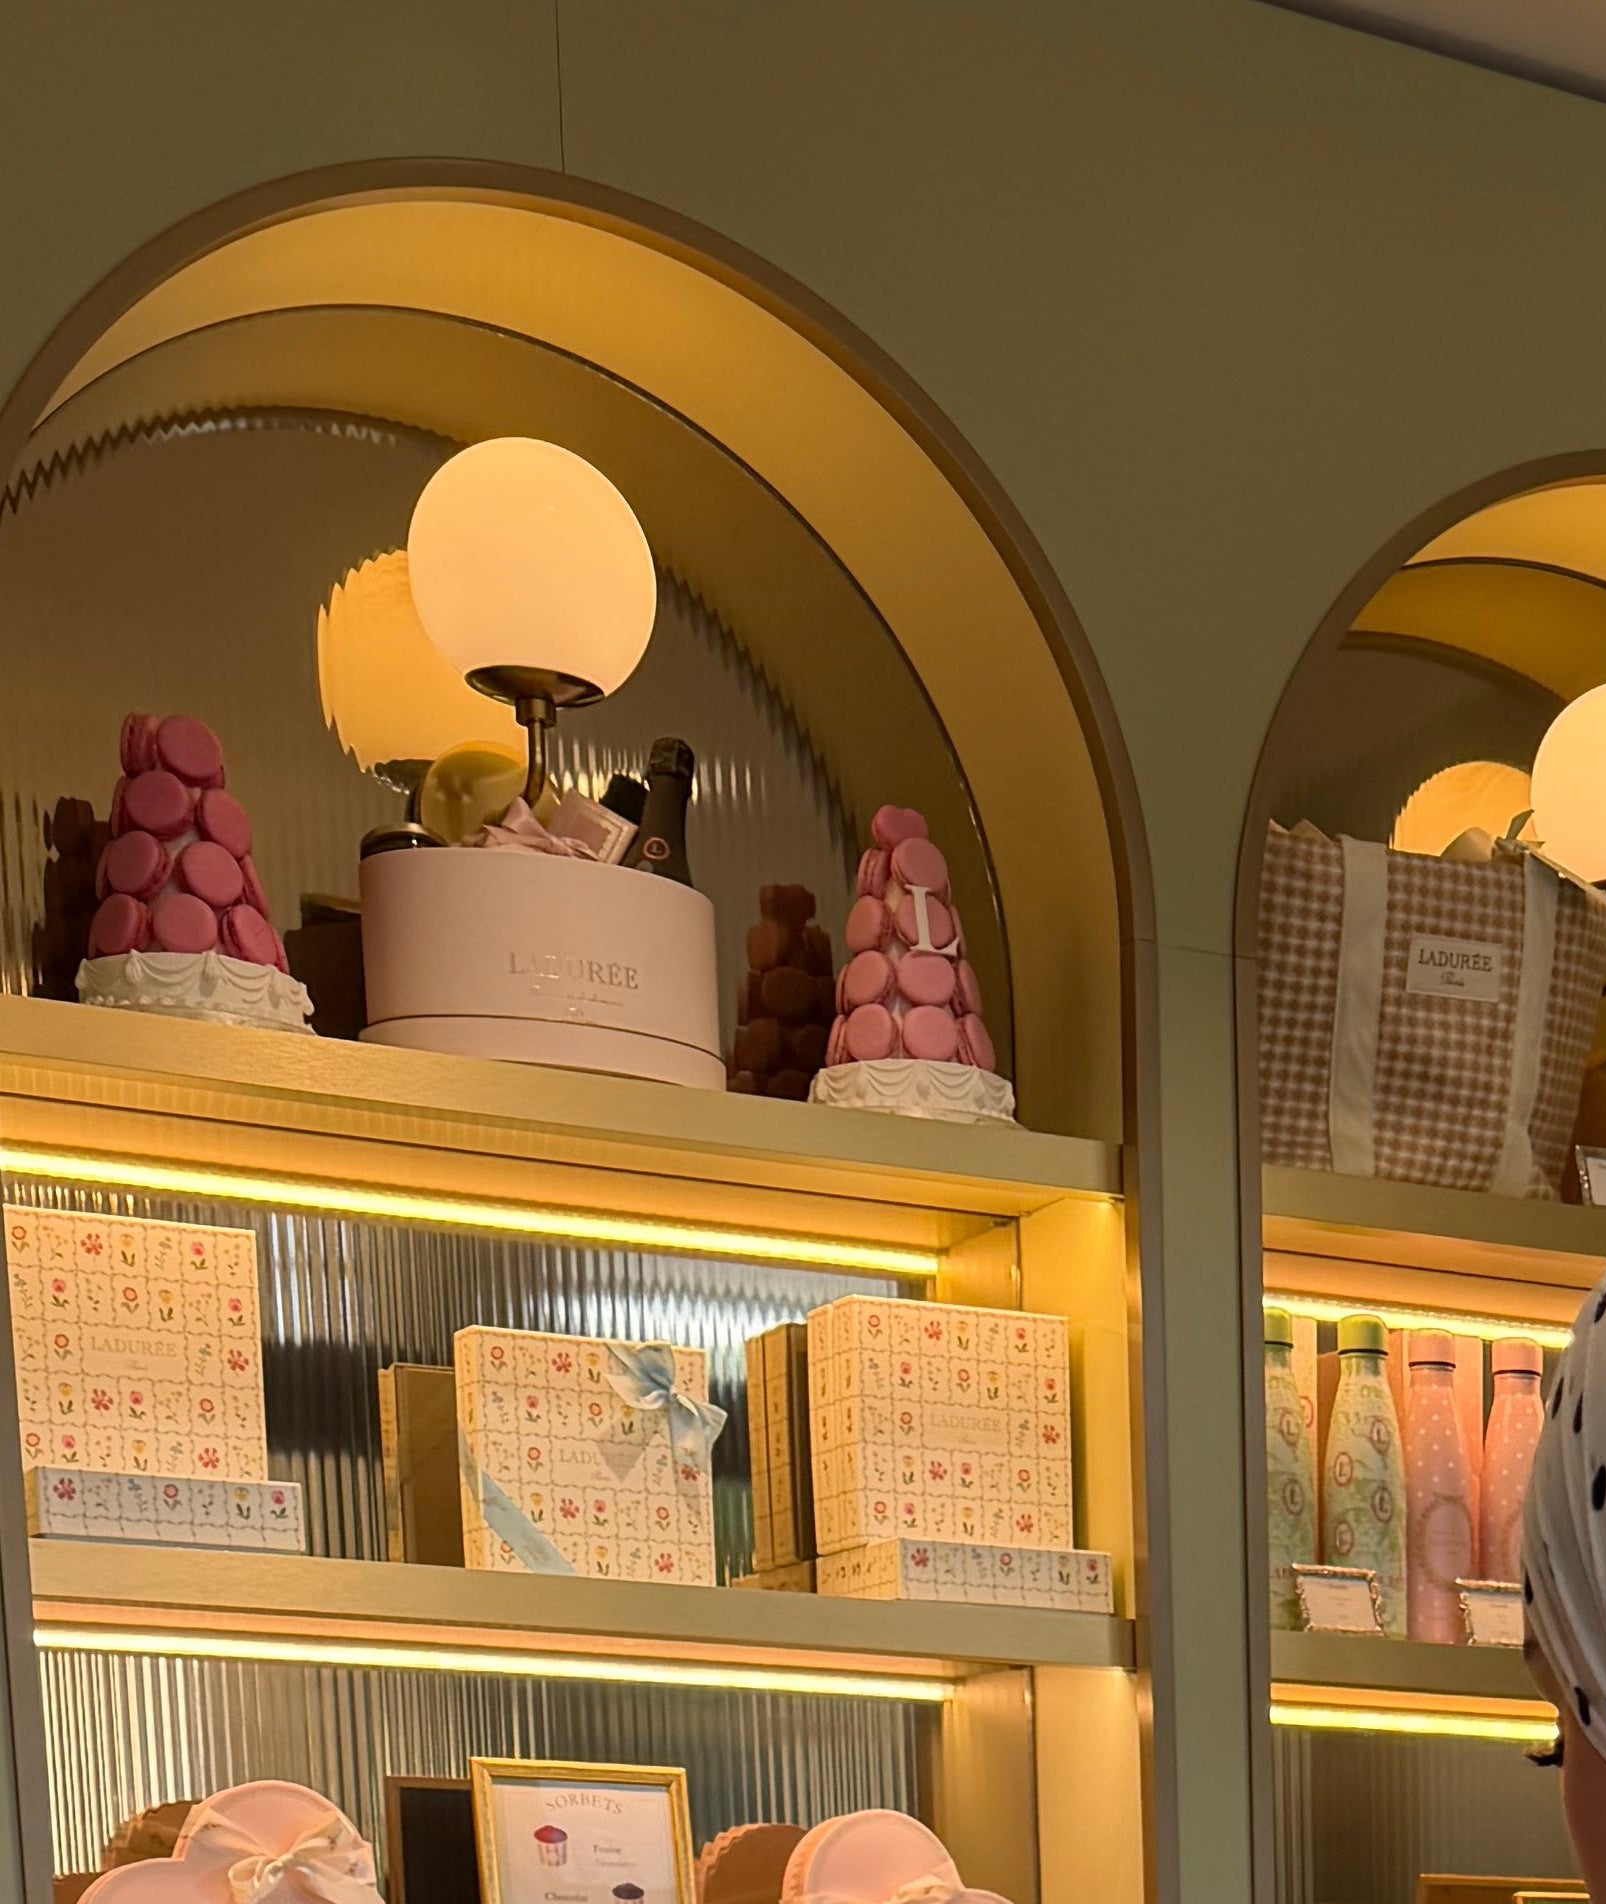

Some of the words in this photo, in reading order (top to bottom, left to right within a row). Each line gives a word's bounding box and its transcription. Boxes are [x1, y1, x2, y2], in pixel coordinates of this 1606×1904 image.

[905, 885, 959, 956] L
[1418, 949, 1492, 972] LADURÉE
[546, 1793, 622, 1815] SORBETS
